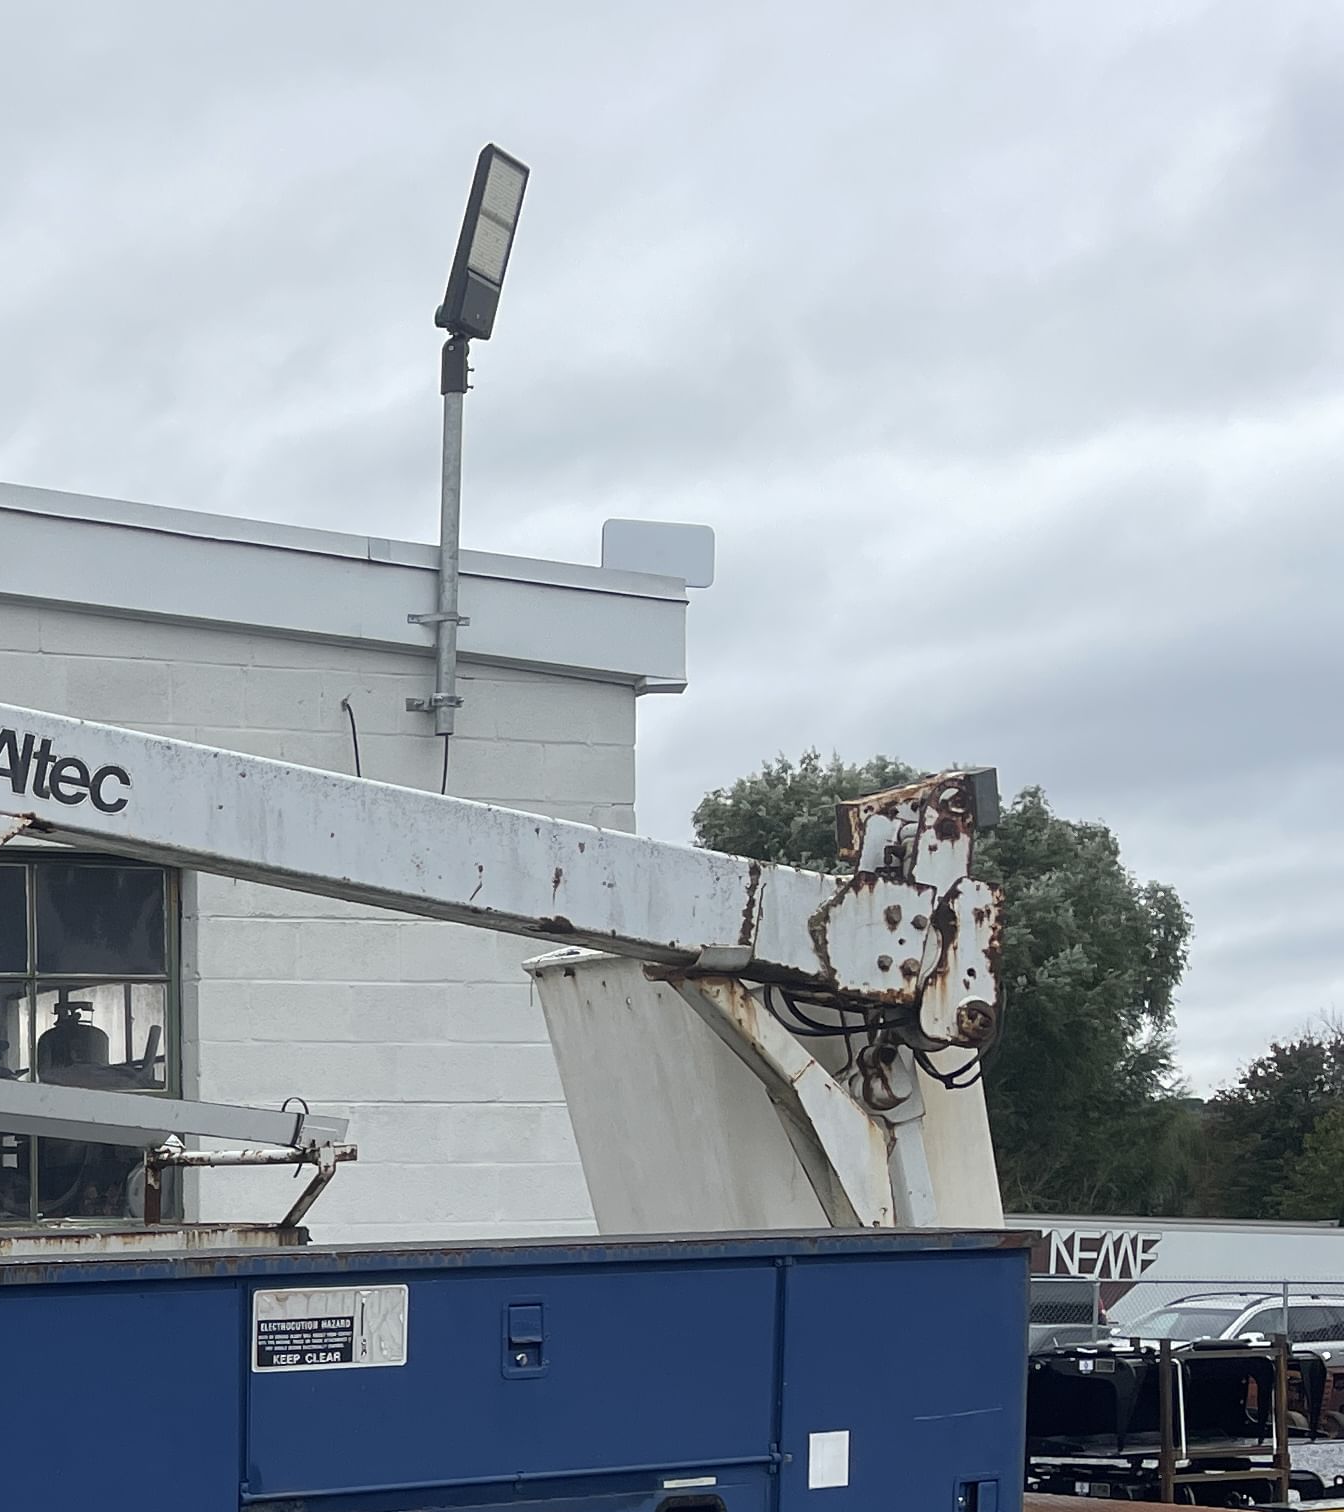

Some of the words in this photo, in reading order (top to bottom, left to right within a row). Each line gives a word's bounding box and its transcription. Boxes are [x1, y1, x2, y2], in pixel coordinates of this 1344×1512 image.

[261, 1320, 318, 1331] ELECTROCUTION
[321, 1319, 351, 1329] HAZARD
[273, 1355, 301, 1365] KEEP
[305, 1352, 341, 1363] CLEAR
